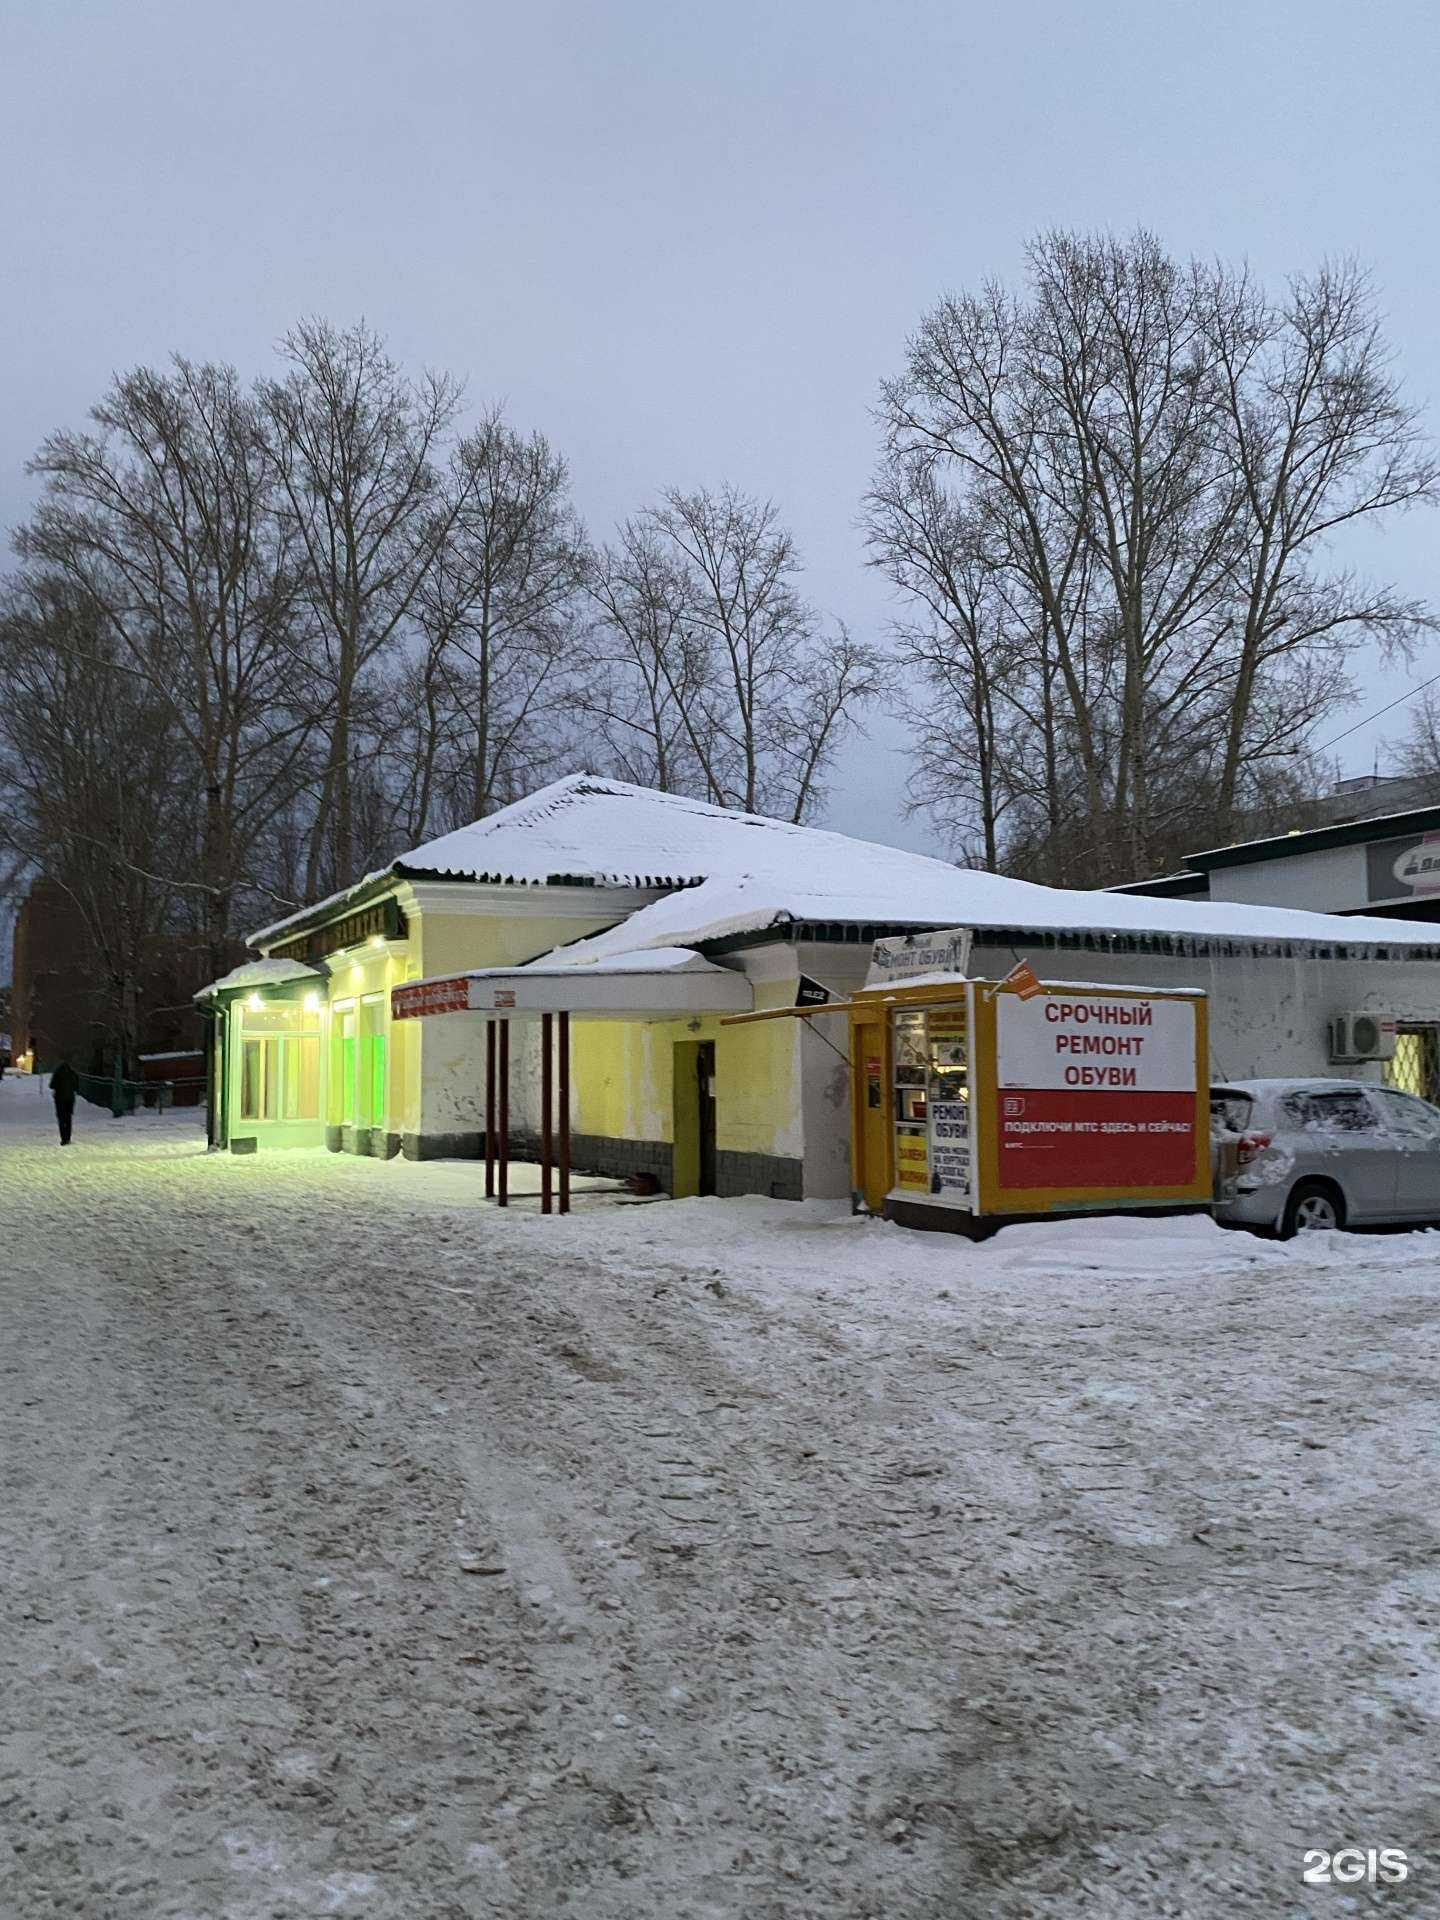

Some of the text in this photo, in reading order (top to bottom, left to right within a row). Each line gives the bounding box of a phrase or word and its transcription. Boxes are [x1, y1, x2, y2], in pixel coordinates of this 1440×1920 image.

[1045, 1001, 1152, 1026] СРОЧНЫЙ
[1055, 1034, 1144, 1056] РЕМОНТ
[1064, 1065, 1136, 1086] ОБУВИ
[1004, 1120, 1192, 1134] ПОДКЛЮЧИ МТС ЗДЕСЬ И СЕЙЧАС!
